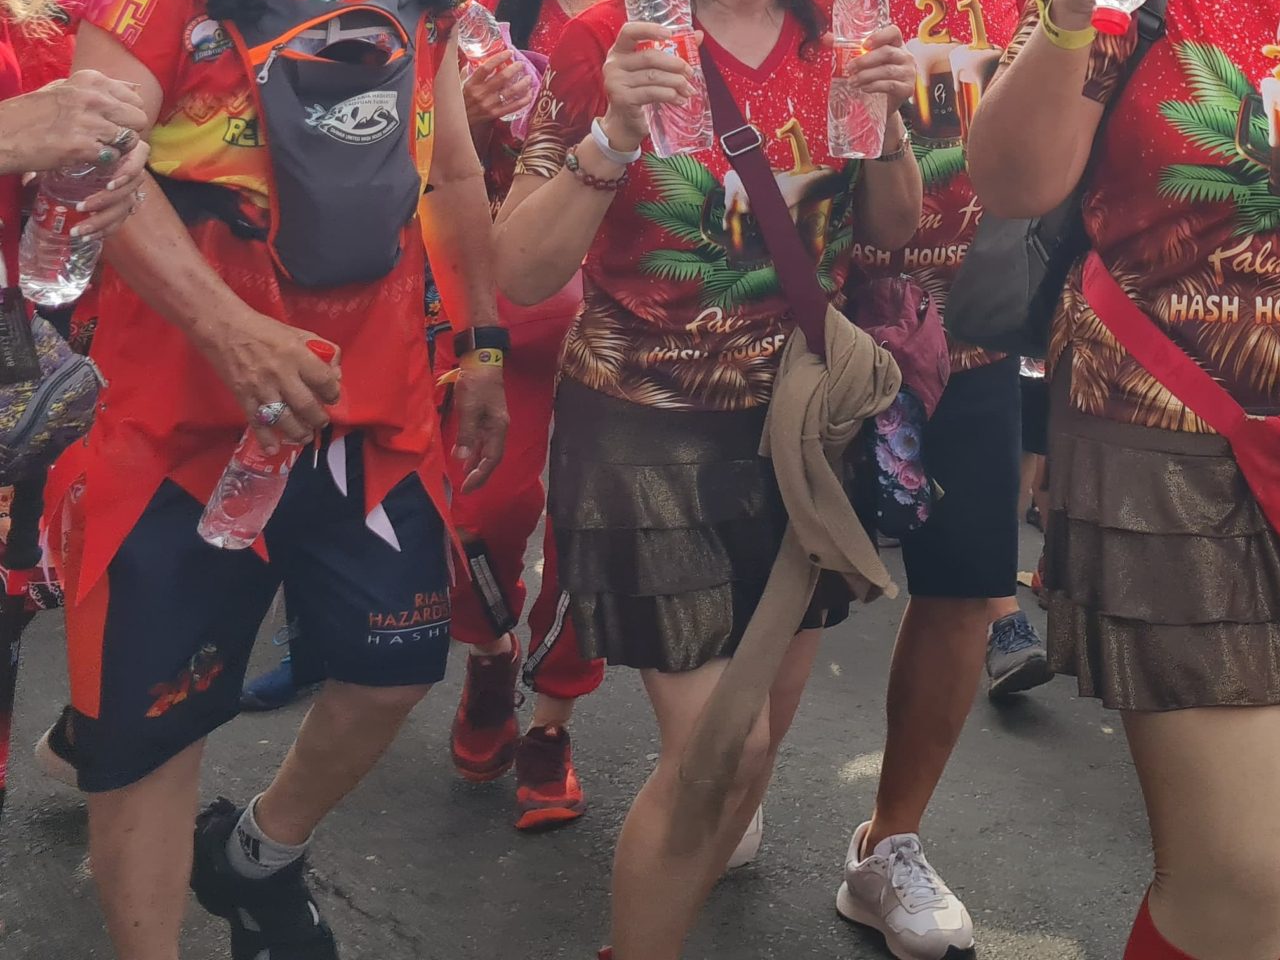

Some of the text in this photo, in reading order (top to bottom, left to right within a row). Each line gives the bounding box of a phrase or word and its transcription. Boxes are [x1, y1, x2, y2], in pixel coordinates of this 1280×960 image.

[851, 243, 968, 266] ASH HOUSE
[1169, 293, 1240, 325] HASH
[414, 592, 448, 607] RIA
